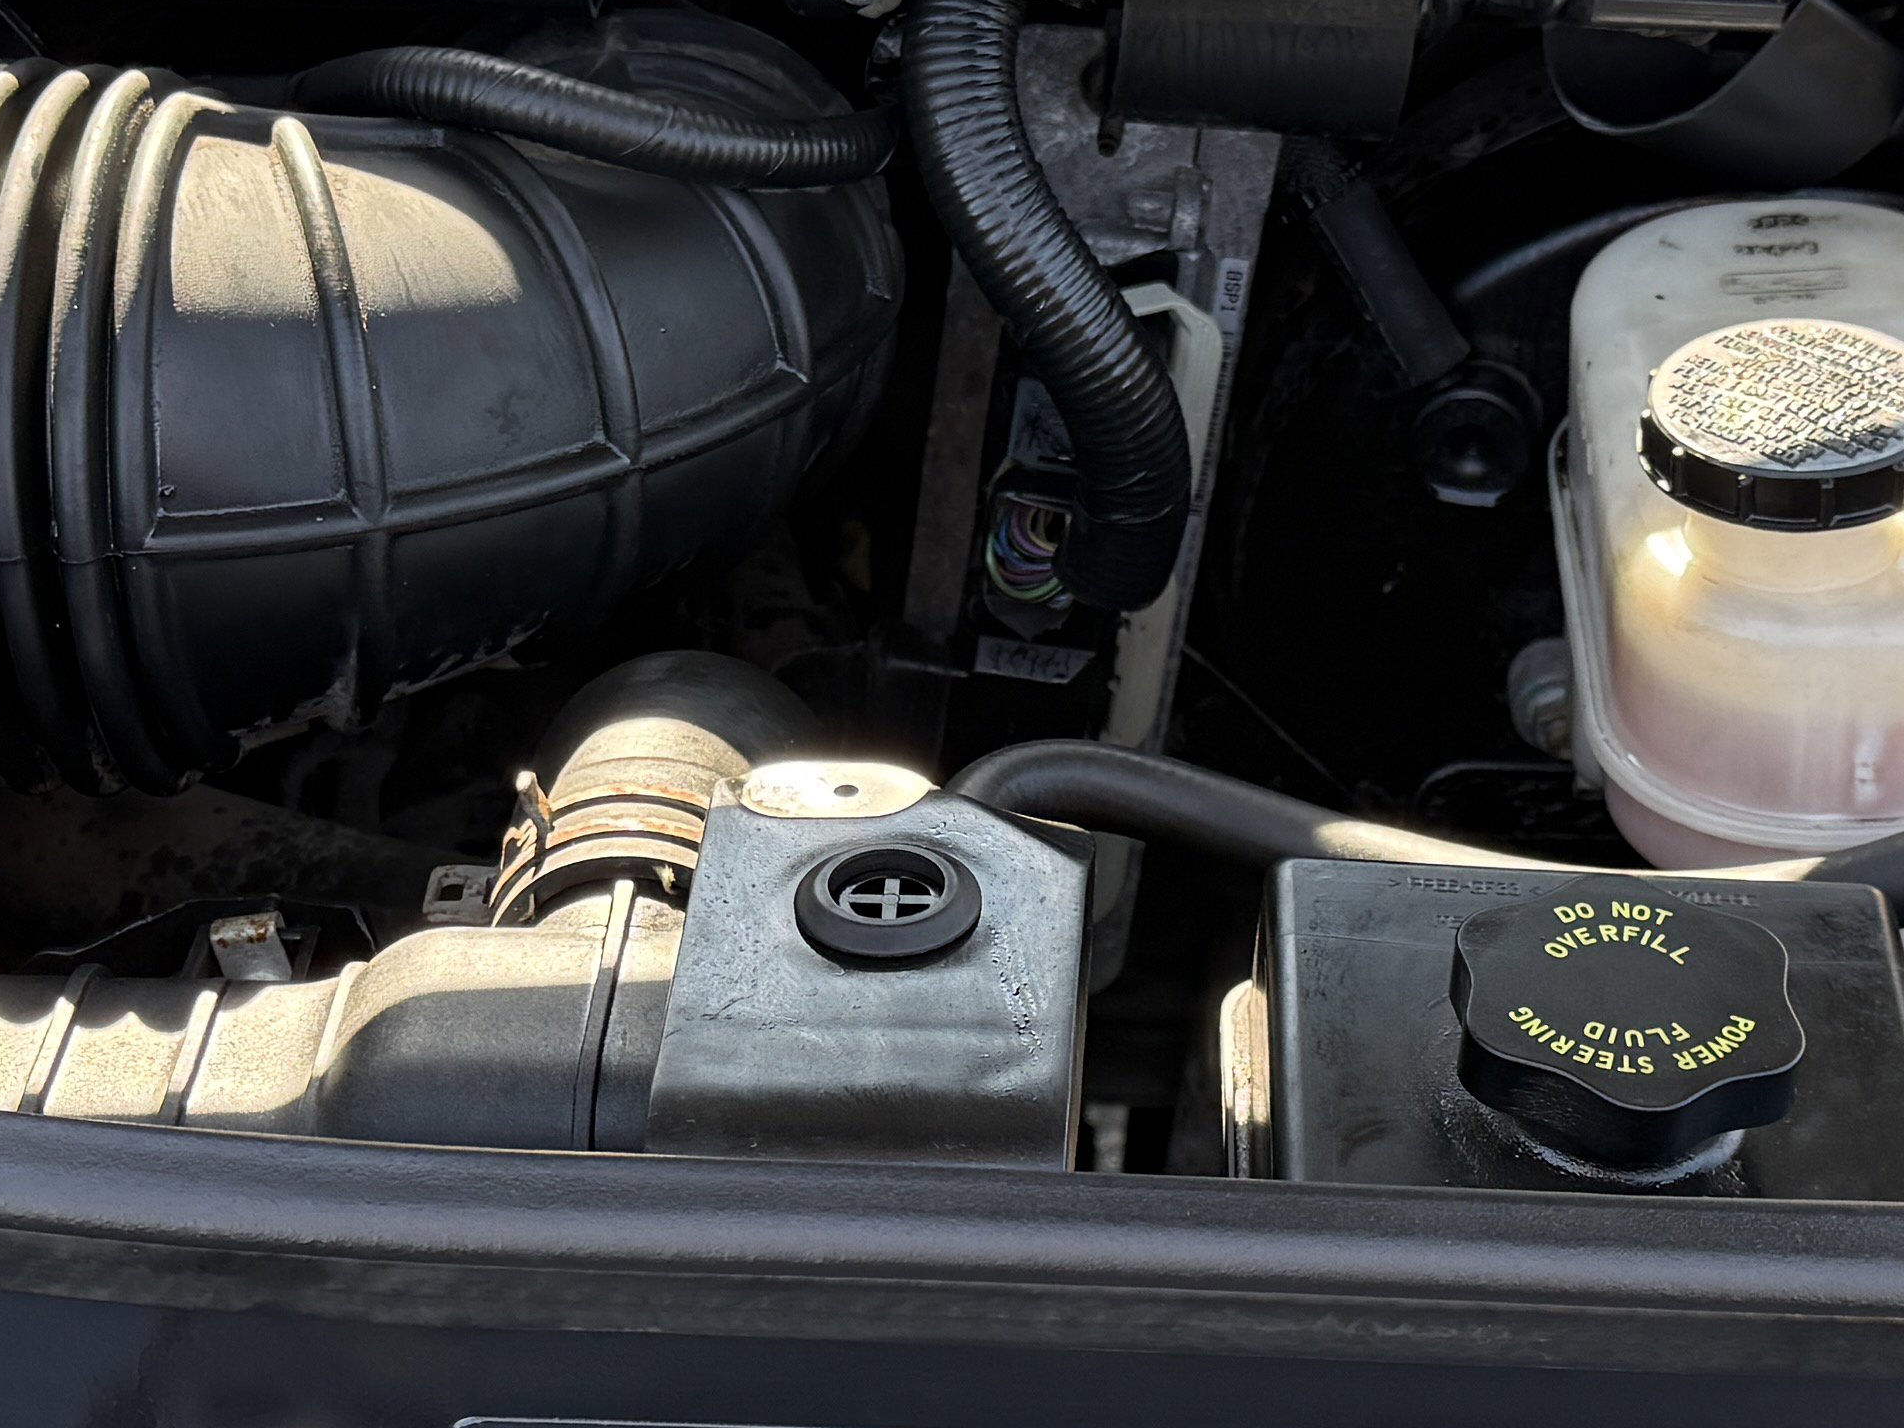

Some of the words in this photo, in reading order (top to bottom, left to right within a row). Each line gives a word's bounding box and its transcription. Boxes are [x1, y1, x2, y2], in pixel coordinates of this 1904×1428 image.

[1552, 900, 1596, 926] DO
[1610, 899, 1675, 926] NOT
[1543, 923, 1692, 967] OVERFILL
[1507, 1005, 1656, 1076] STEERING
[1582, 1020, 1691, 1048] FLUID
[1671, 1013, 1757, 1072] POWER
